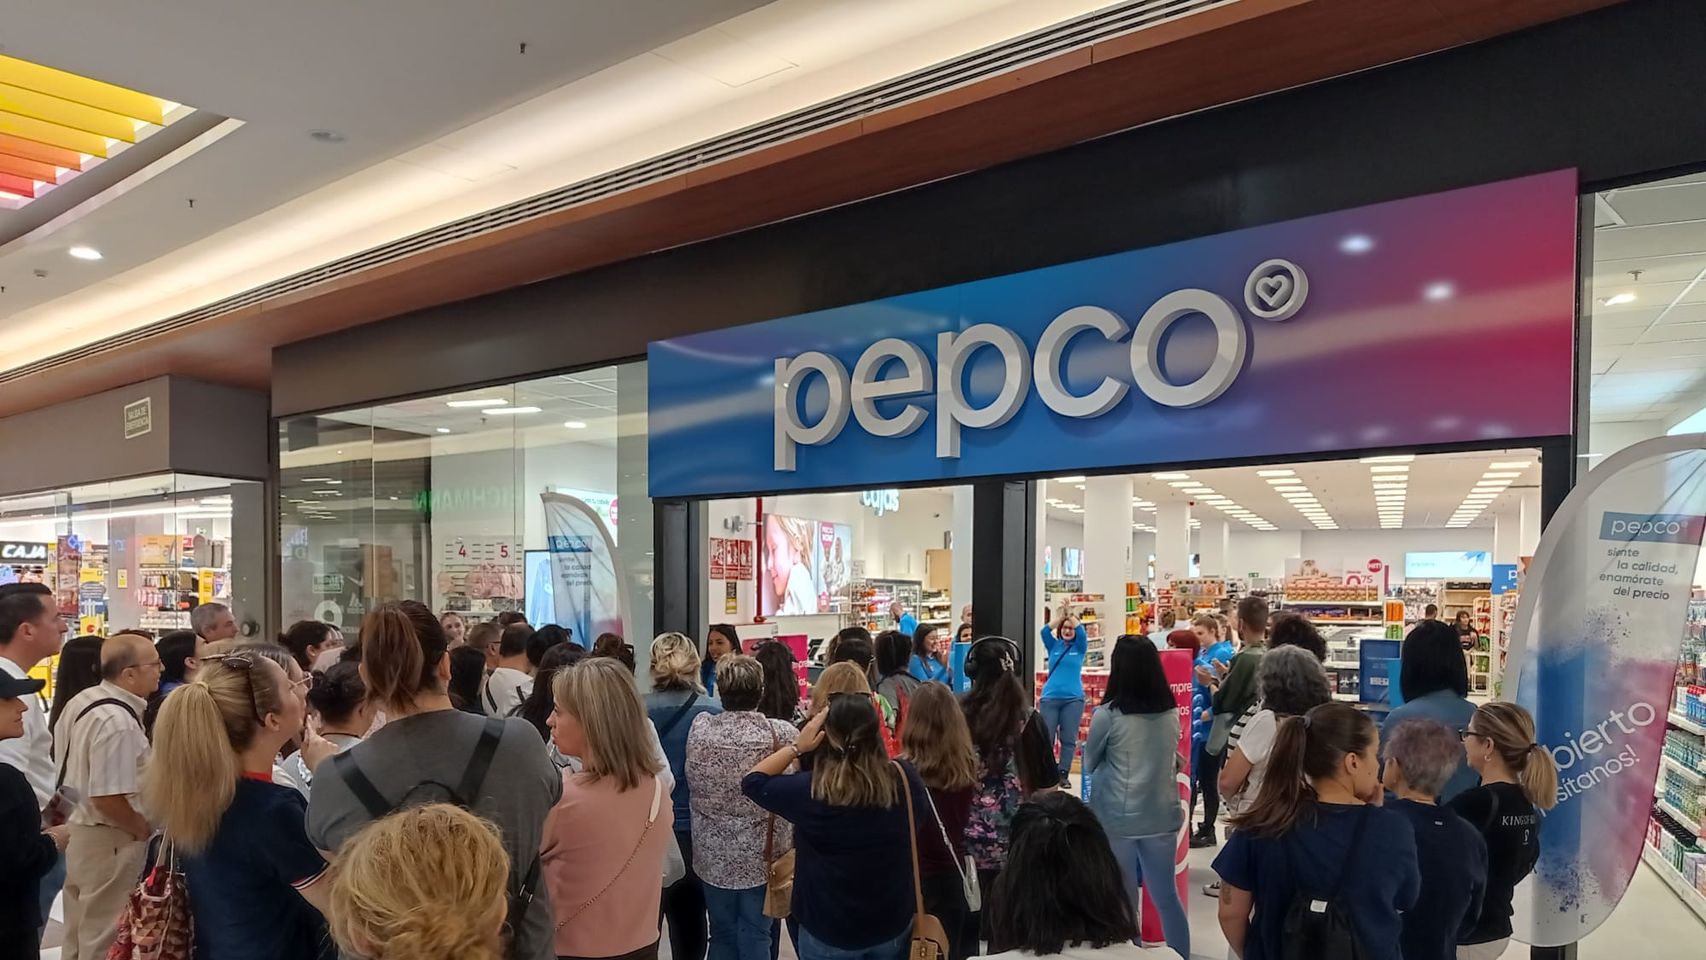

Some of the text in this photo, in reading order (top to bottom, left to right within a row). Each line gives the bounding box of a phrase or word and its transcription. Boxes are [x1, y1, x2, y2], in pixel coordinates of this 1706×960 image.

[774, 288, 1249, 472] pepco
[862, 487, 900, 517] cajas
[1610, 519, 1681, 537] pepco
[1, 543, 47, 559] CAJA
[458, 544, 467, 558] 4
[500, 545, 509, 558] 5
[1607, 547, 1640, 557] siente
[1616, 560, 1679, 575] la calidad,
[1600, 573, 1664, 586] enamórate
[1613, 586, 1670, 600] del precio
[1170, 682, 1193, 695] mpre
[1541, 702, 1656, 773] bierto
[1540, 744, 1641, 817] sítanos!
